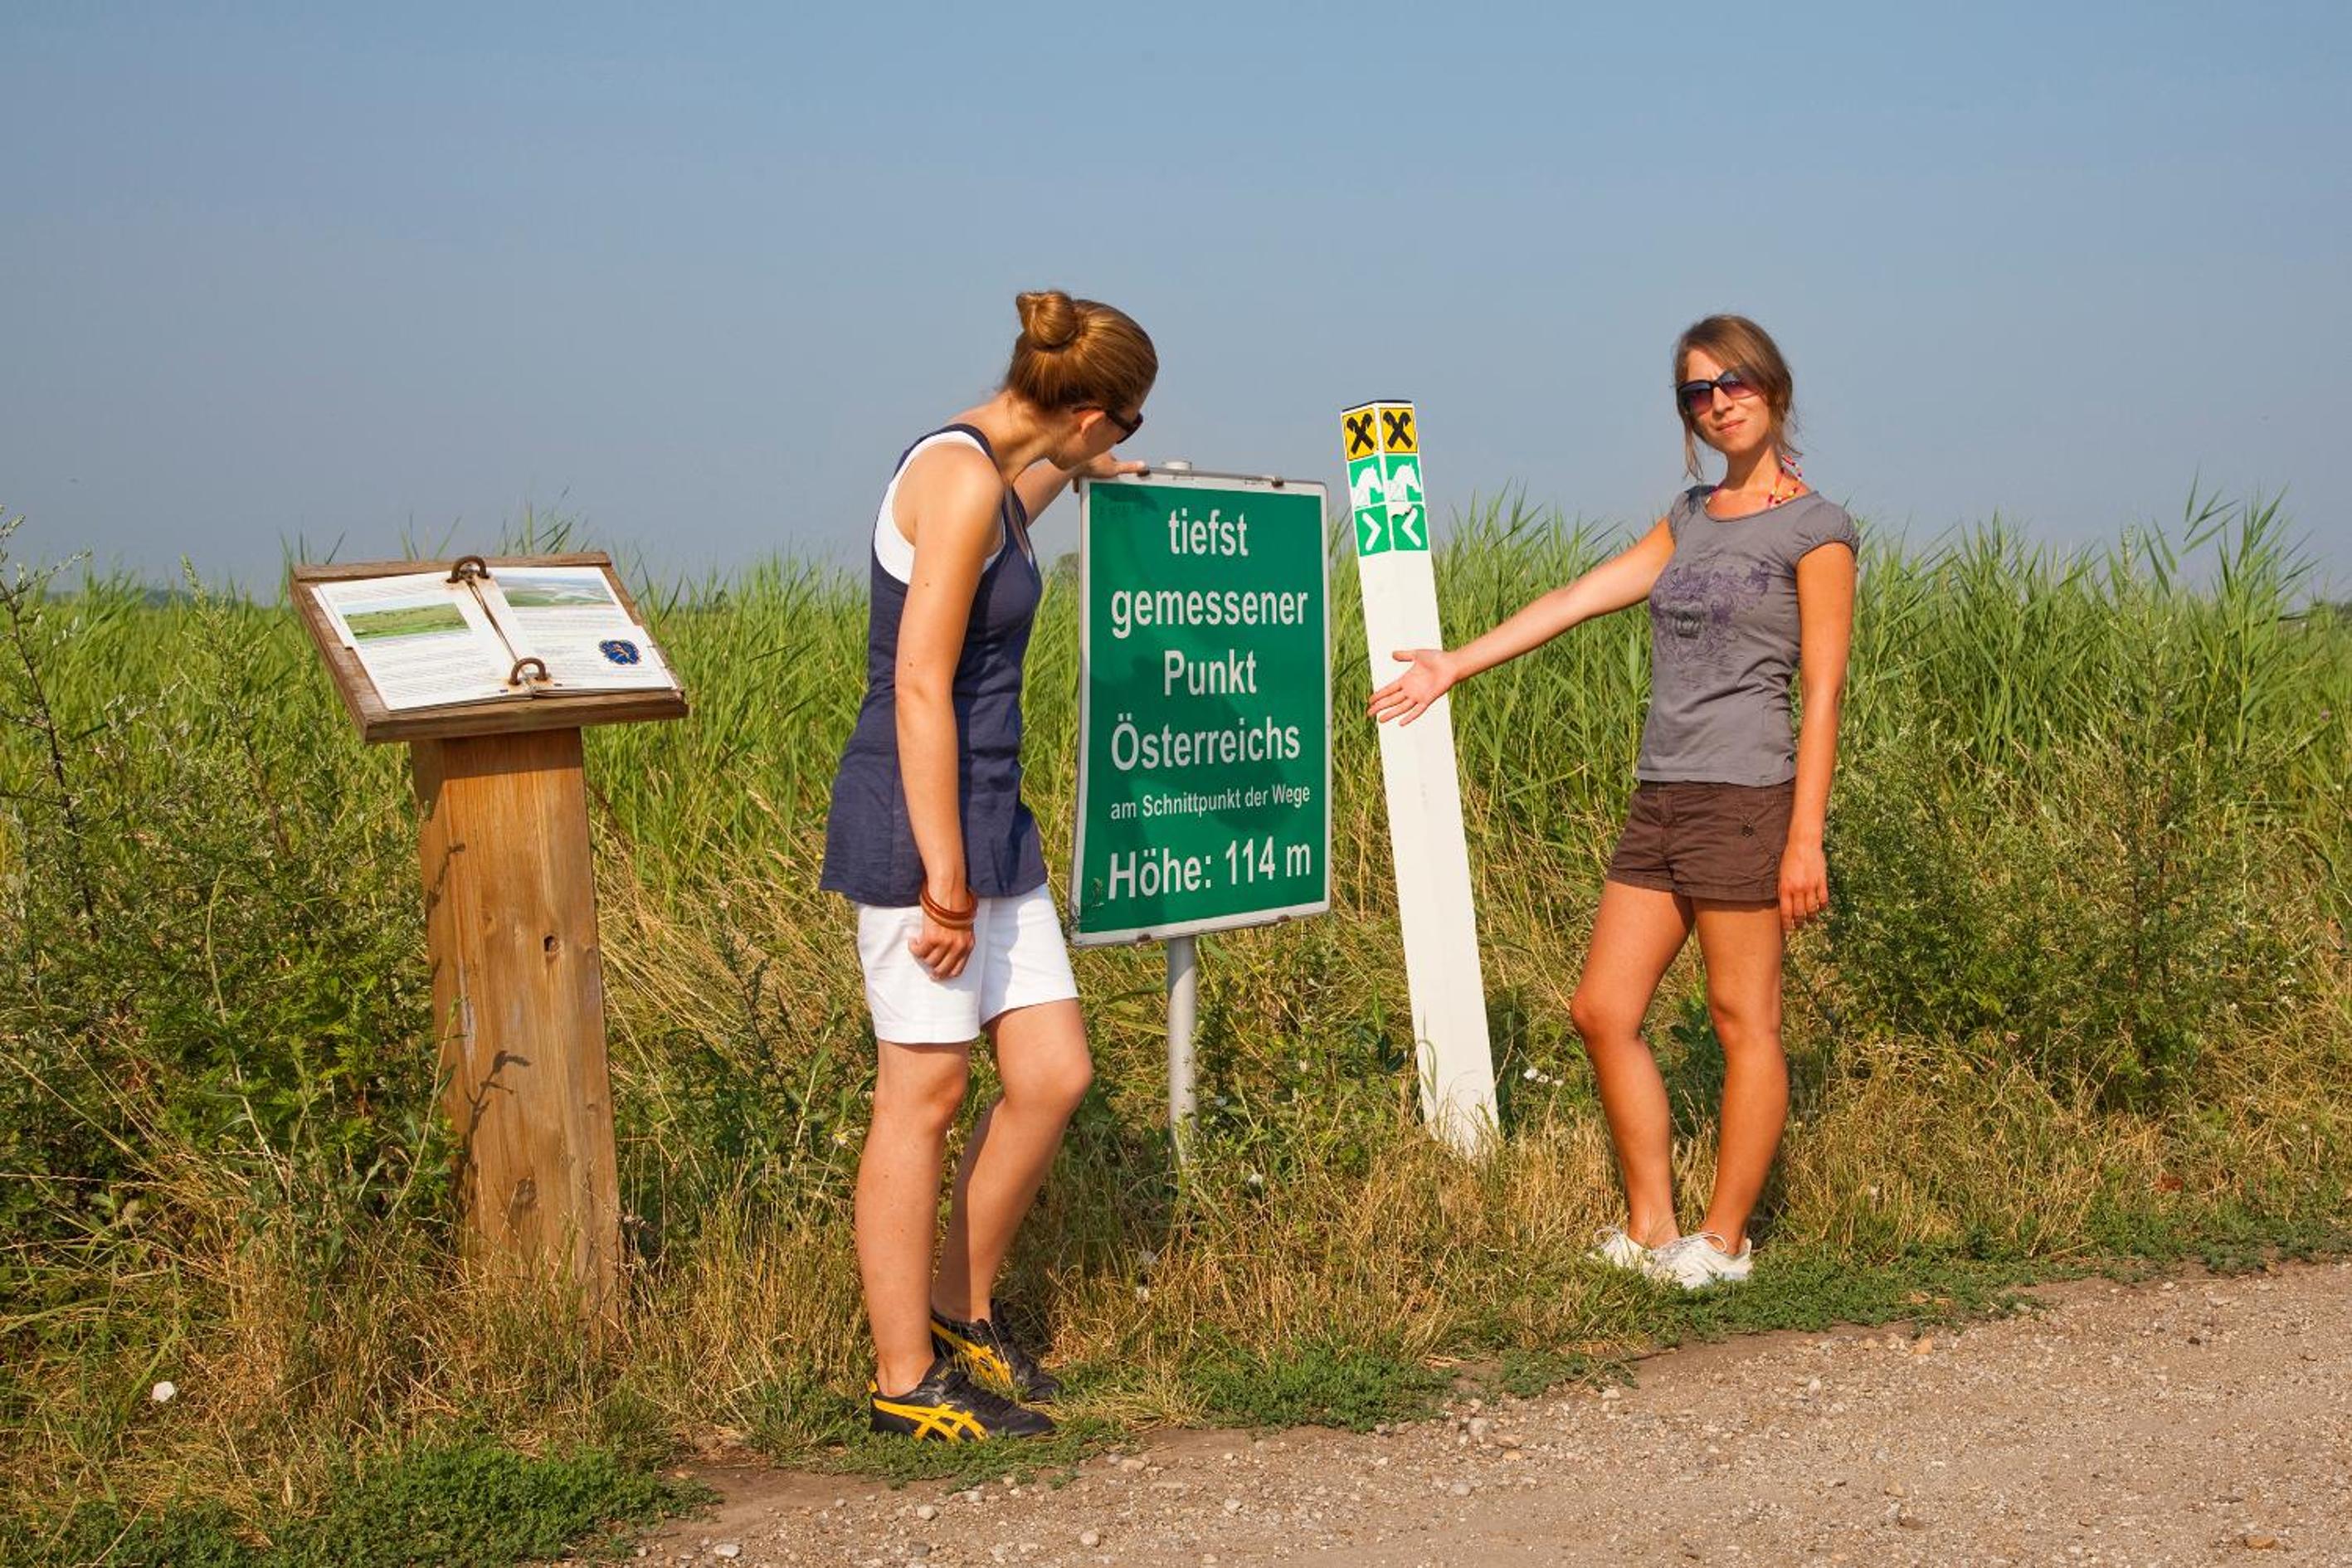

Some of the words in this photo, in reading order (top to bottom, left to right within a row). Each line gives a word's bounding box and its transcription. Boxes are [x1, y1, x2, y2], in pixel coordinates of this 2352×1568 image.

[1168, 508, 1249, 556] tiefst
[1111, 589, 1308, 639] gemessener
[1164, 649, 1257, 696] Punkt
[1111, 713, 1301, 771] Österreichs
[1111, 801, 1137, 820] am
[1142, 791, 1241, 818] Schnittpunkt
[1244, 786, 1268, 807] der
[1272, 783, 1311, 809] Wege
[1108, 847, 1212, 900] Höhe:
[1225, 835, 1275, 885] 114
[1286, 843, 1311, 878] m
